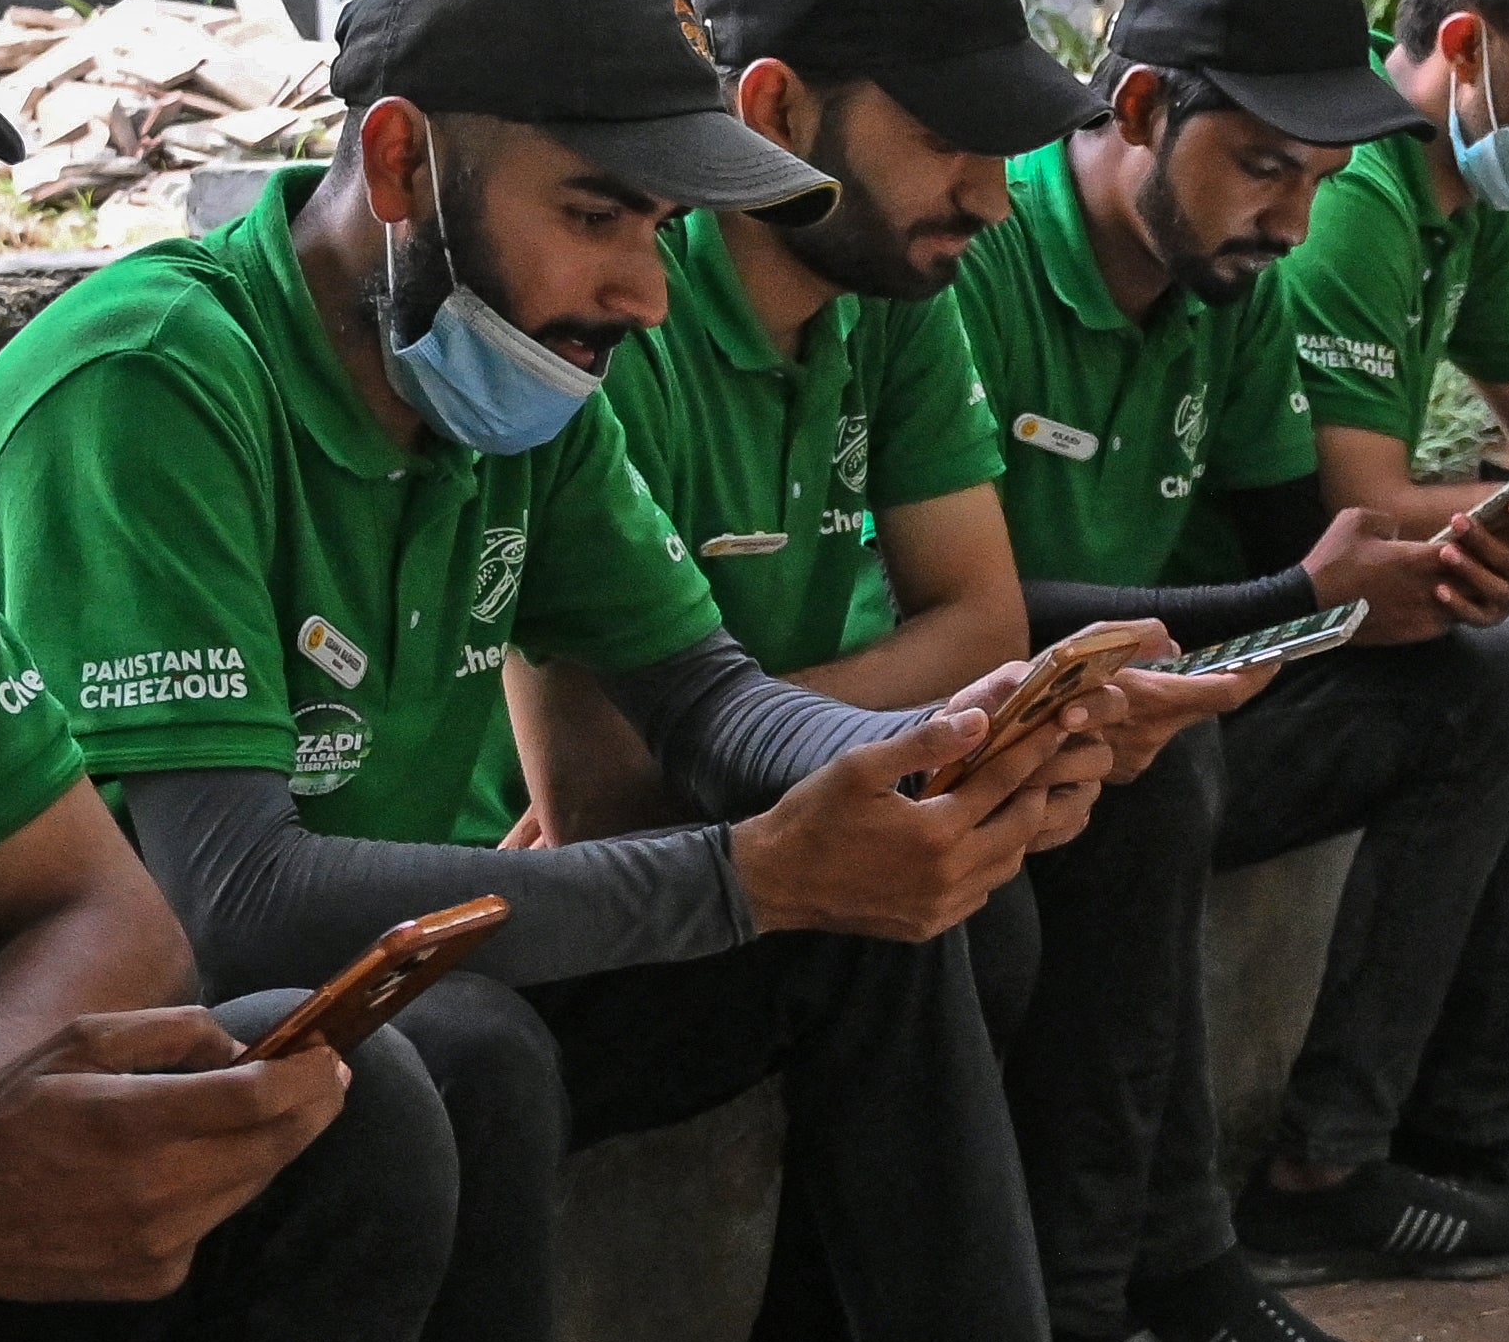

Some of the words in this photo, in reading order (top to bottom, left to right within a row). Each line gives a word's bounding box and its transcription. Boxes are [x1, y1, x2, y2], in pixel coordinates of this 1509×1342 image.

[81, 649, 202, 683] PAKISTAN
[207, 647, 245, 670] KA
[297, 733, 362, 753] ZADI
[296, 760, 361, 772] EBRATION
